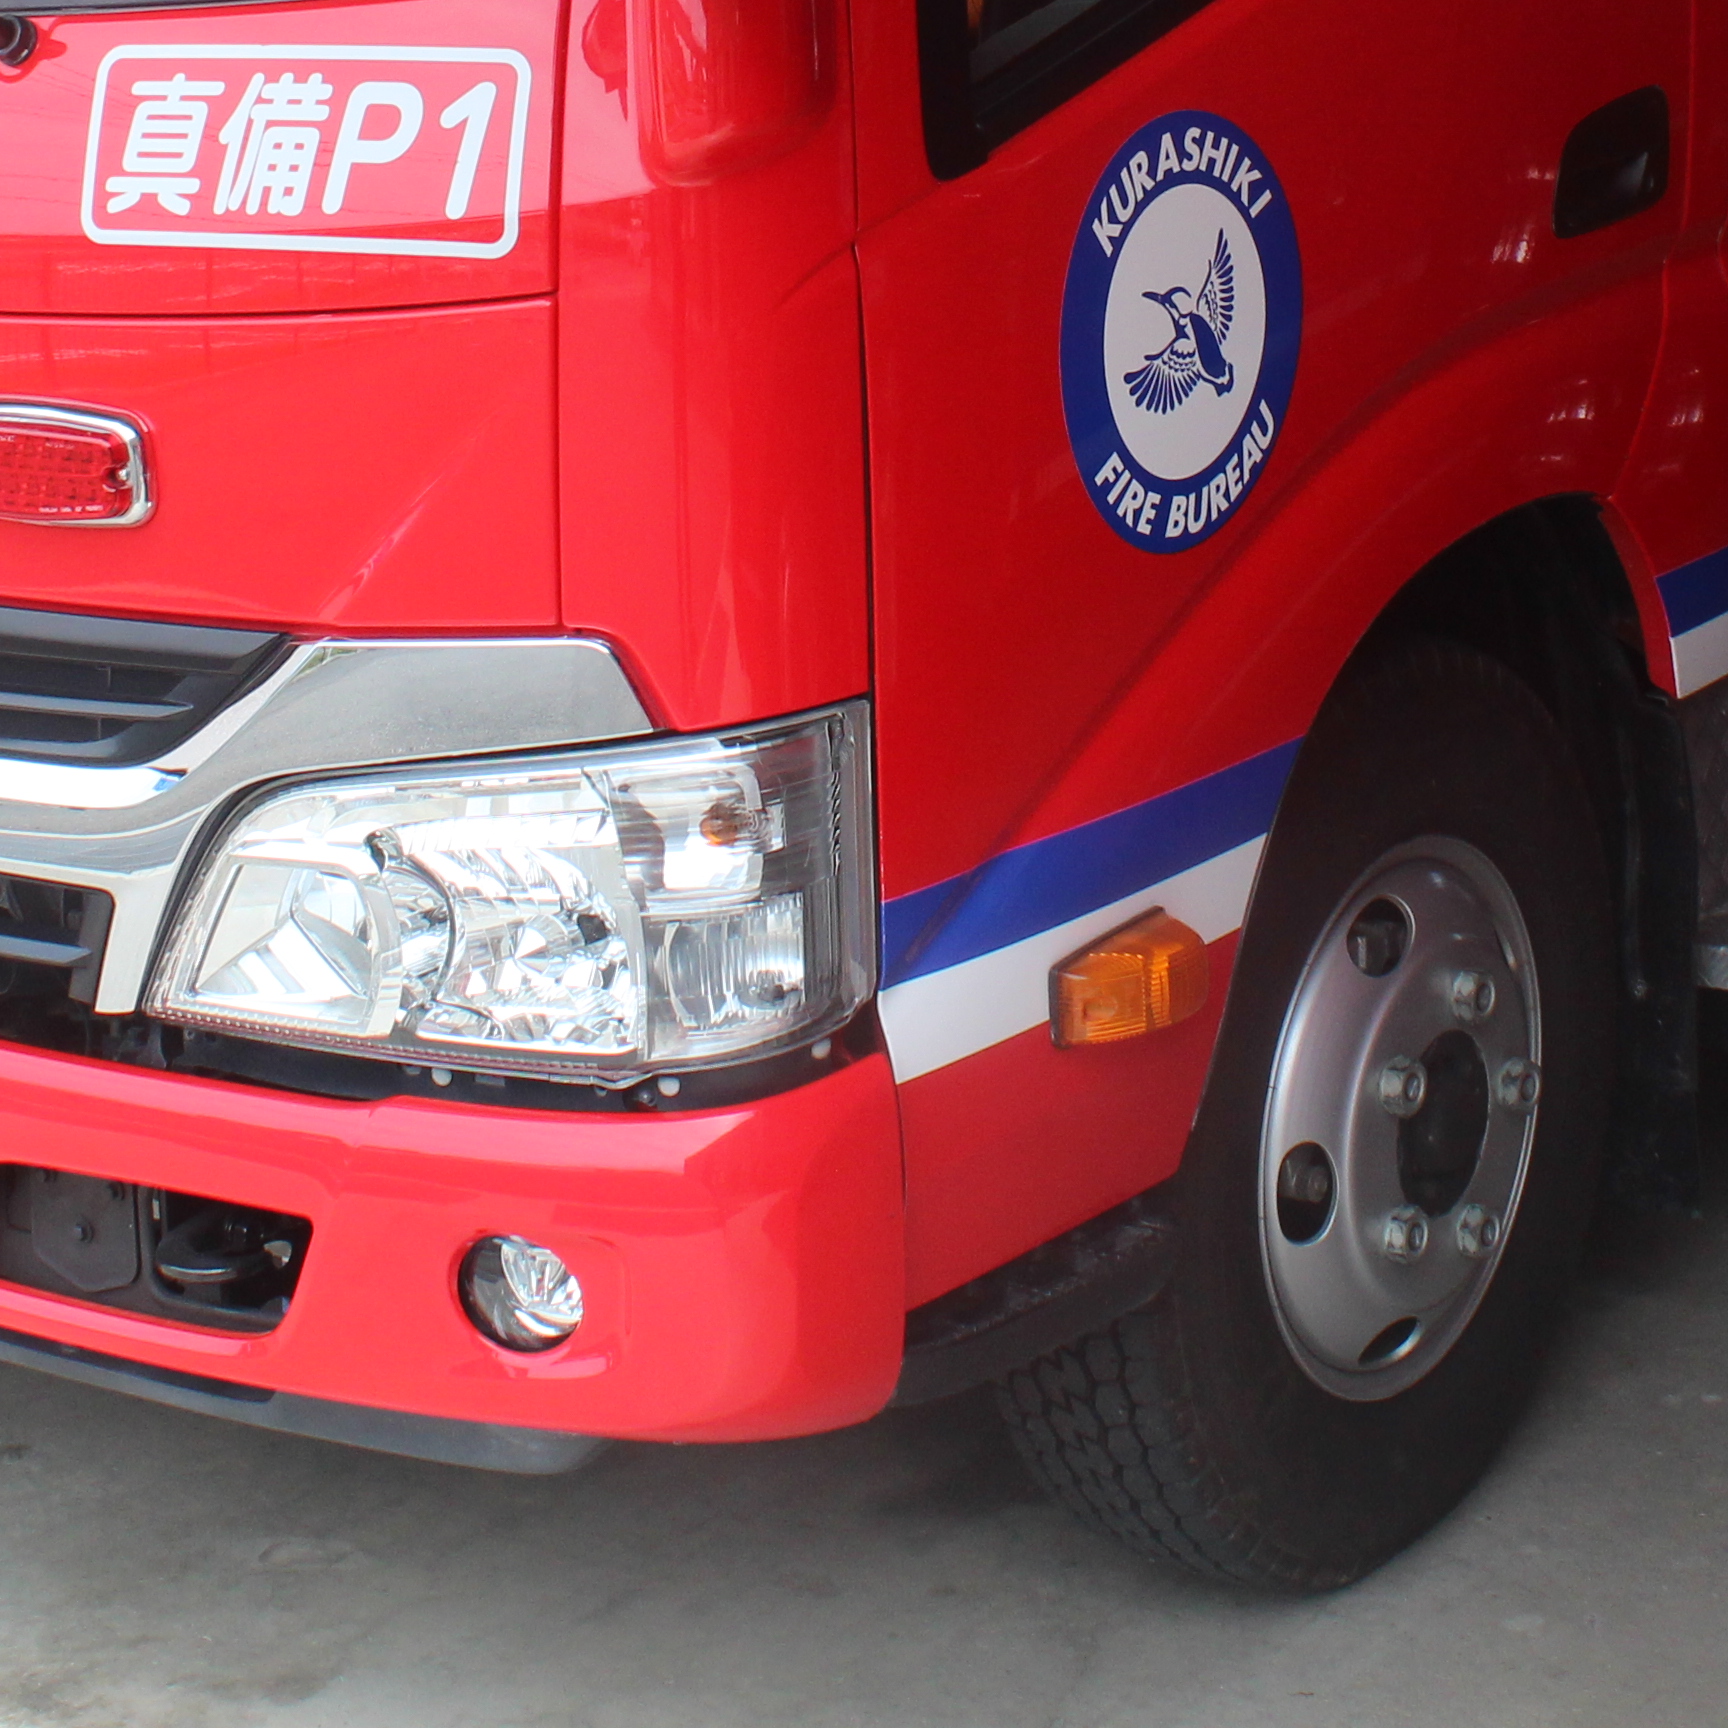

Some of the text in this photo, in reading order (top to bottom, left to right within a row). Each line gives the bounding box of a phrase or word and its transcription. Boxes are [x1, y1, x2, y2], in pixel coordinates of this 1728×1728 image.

[105, 72, 497, 220] 真備P1
[1092, 127, 1272, 258] KURASHIKI
[1094, 399, 1275, 539] FIRE BUREAU
